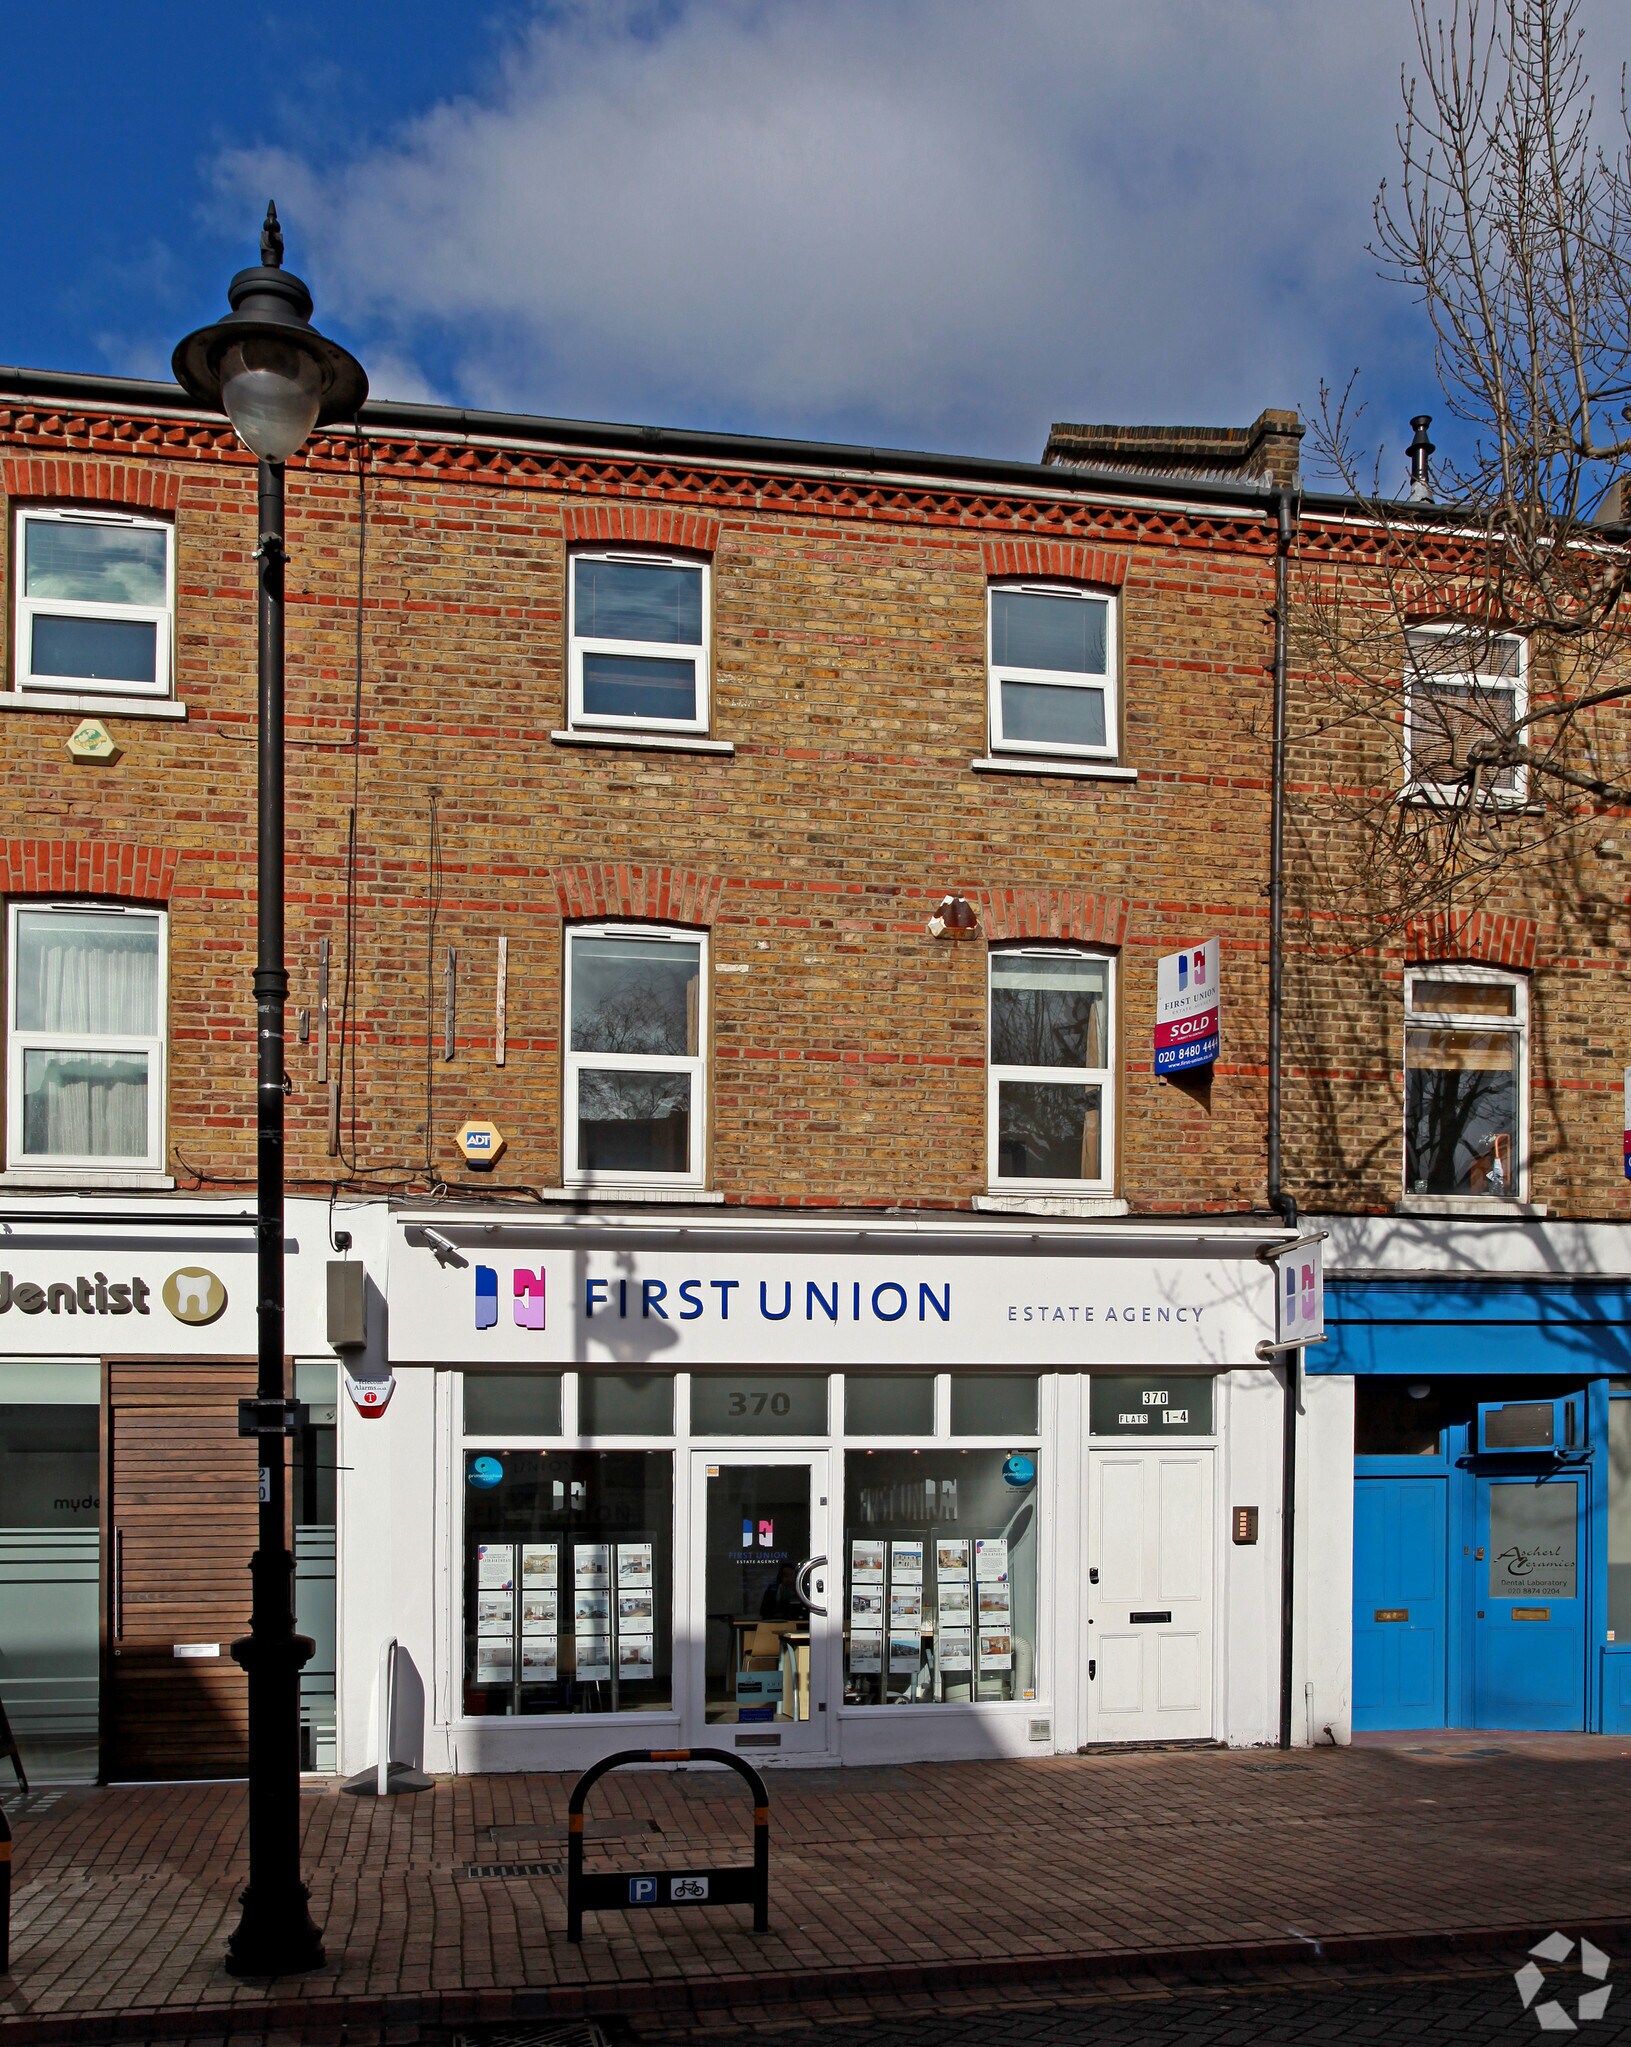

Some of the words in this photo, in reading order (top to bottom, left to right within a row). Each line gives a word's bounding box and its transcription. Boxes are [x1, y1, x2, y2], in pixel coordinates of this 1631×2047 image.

[1164, 997, 1191, 1010] FIRST
[1194, 987, 1216, 1002] UNION
[1170, 1016, 1209, 1037] SOLD
[1158, 1051, 1175, 1063] 020
[1178, 1044, 1200, 1059] 8480
[467, 1135, 490, 1145] ADT
[586, 1279, 739, 1319] FIRST
[760, 1281, 950, 1321] UNION
[1008, 1306, 1094, 1321] ESTATE
[1105, 1307, 1203, 1322] AGENCY
[728, 1392, 790, 1416] 370
[1144, 1393, 1167, 1403] 370
[1120, 1415, 1147, 1423] FLATS
[1165, 1411, 1186, 1422] 1-4
[728, 1551, 753, 1559] FIRST
[756, 1551, 788, 1559] UNION
[1508, 1556, 1575, 1576] Ceramics
[635, 1881, 652, 1900] P
